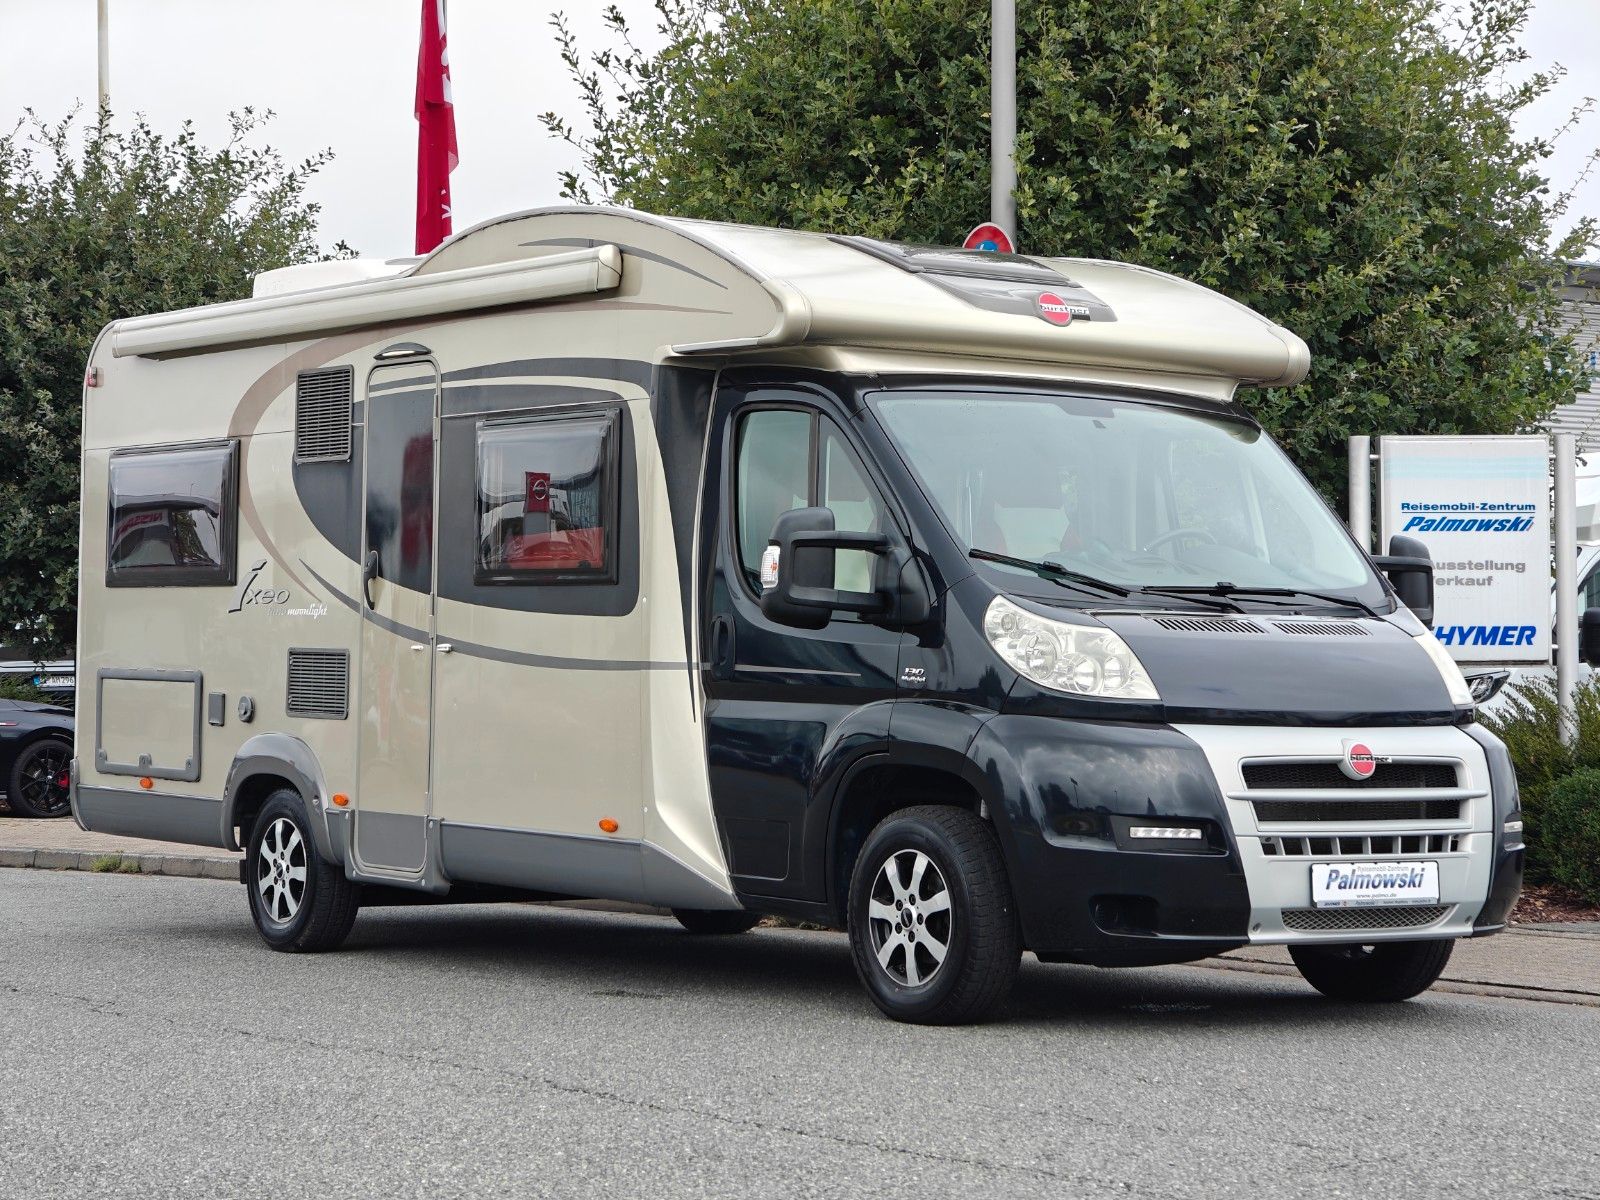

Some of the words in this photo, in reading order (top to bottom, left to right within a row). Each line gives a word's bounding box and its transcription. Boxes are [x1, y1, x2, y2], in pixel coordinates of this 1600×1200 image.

[1401, 502, 1536, 511] Reisemobil-Zentrum
[1402, 516, 1535, 532] Palmowski
[1433, 576, 1494, 586] erkauf
[287, 603, 328, 619] moonlight
[1434, 625, 1537, 646] HYMER
[905, 667, 925, 675] 130
[1326, 868, 1425, 889] Palmowski
